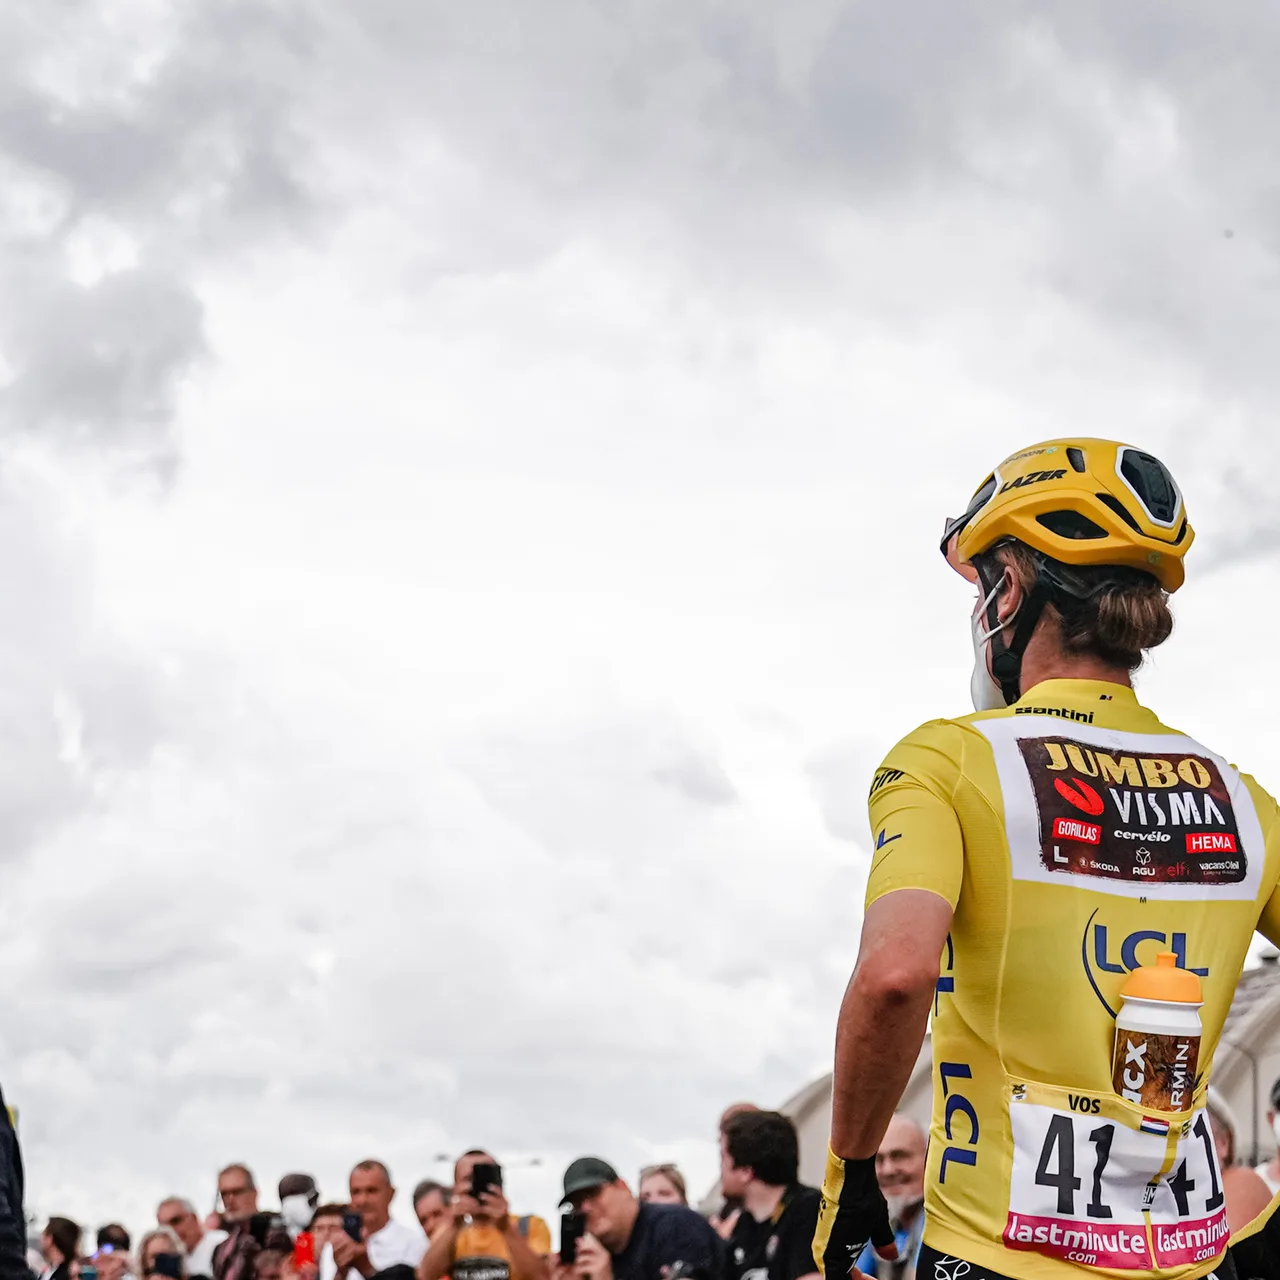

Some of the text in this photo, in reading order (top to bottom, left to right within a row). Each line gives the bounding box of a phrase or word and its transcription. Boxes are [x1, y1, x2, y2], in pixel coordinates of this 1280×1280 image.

[998, 469, 1068, 495] LAZER
[1015, 706, 1094, 724] santini
[1044, 743, 1212, 789] JUMBO
[1108, 787, 1226, 826] VISMA
[1058, 821, 1098, 841] GORILLAS
[1114, 829, 1171, 842] cervélo
[1192, 836, 1232, 851] HEMA
[1090, 860, 1120, 873] ŠKODA
[1133, 866, 1156, 876] AGU
[1094, 925, 1209, 976] LCL
[1068, 1094, 1101, 1114] VOS
[939, 1061, 980, 1185] LCL
[1035, 1113, 1116, 1219] 41
[1008, 1216, 1147, 1255] lastminute
[1157, 1209, 1231, 1252] lastminut
[1064, 1251, 1098, 1265] .com
[1193, 1246, 1217, 1262] .com
